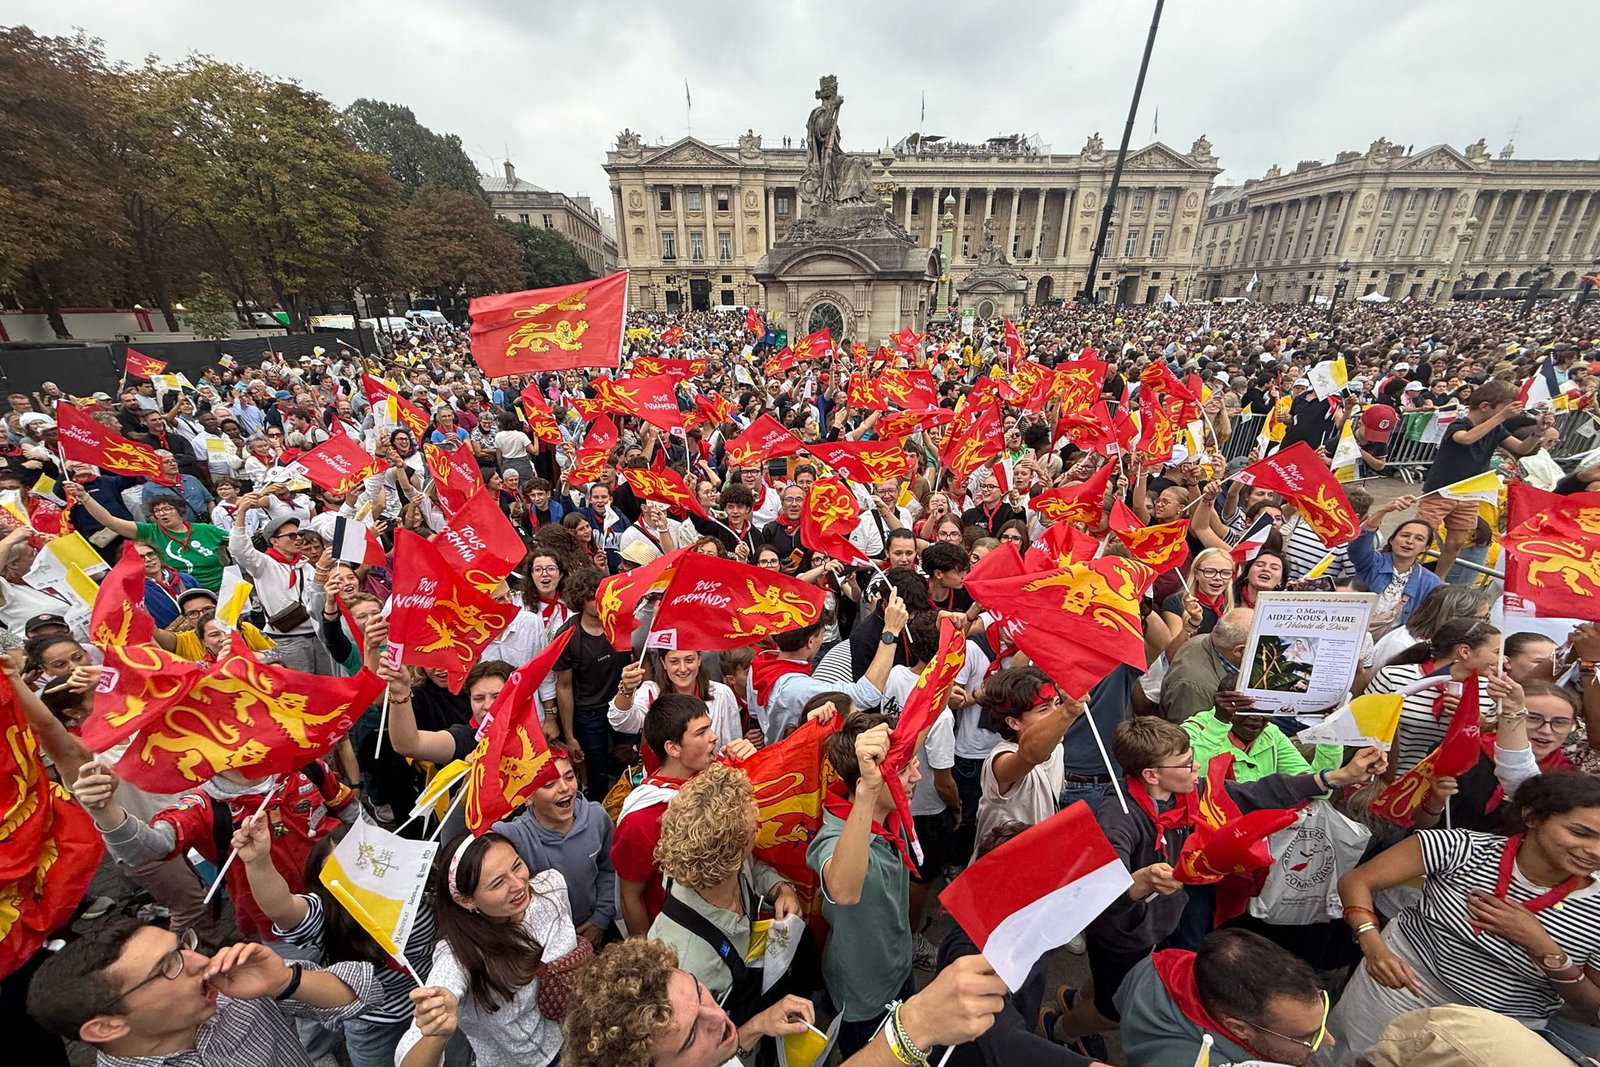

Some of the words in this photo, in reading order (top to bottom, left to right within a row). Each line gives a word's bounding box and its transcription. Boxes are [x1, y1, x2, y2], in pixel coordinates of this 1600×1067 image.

[71, 424, 92, 437] TOUS
[1266, 459, 1304, 491] NORMANDS
[1284, 463, 1305, 481] TOUS
[460, 524, 487, 550] TOUS
[417, 577, 438, 596] TOUS
[694, 580, 722, 593] TOUS
[670, 592, 731, 608] NORMANDS
[1266, 614, 1321, 622] AIDEZ-NOUS
[1330, 615, 1356, 623] FAIRE
[1284, 621, 1315, 629] Volonté
[1326, 623, 1349, 631] Dieu
